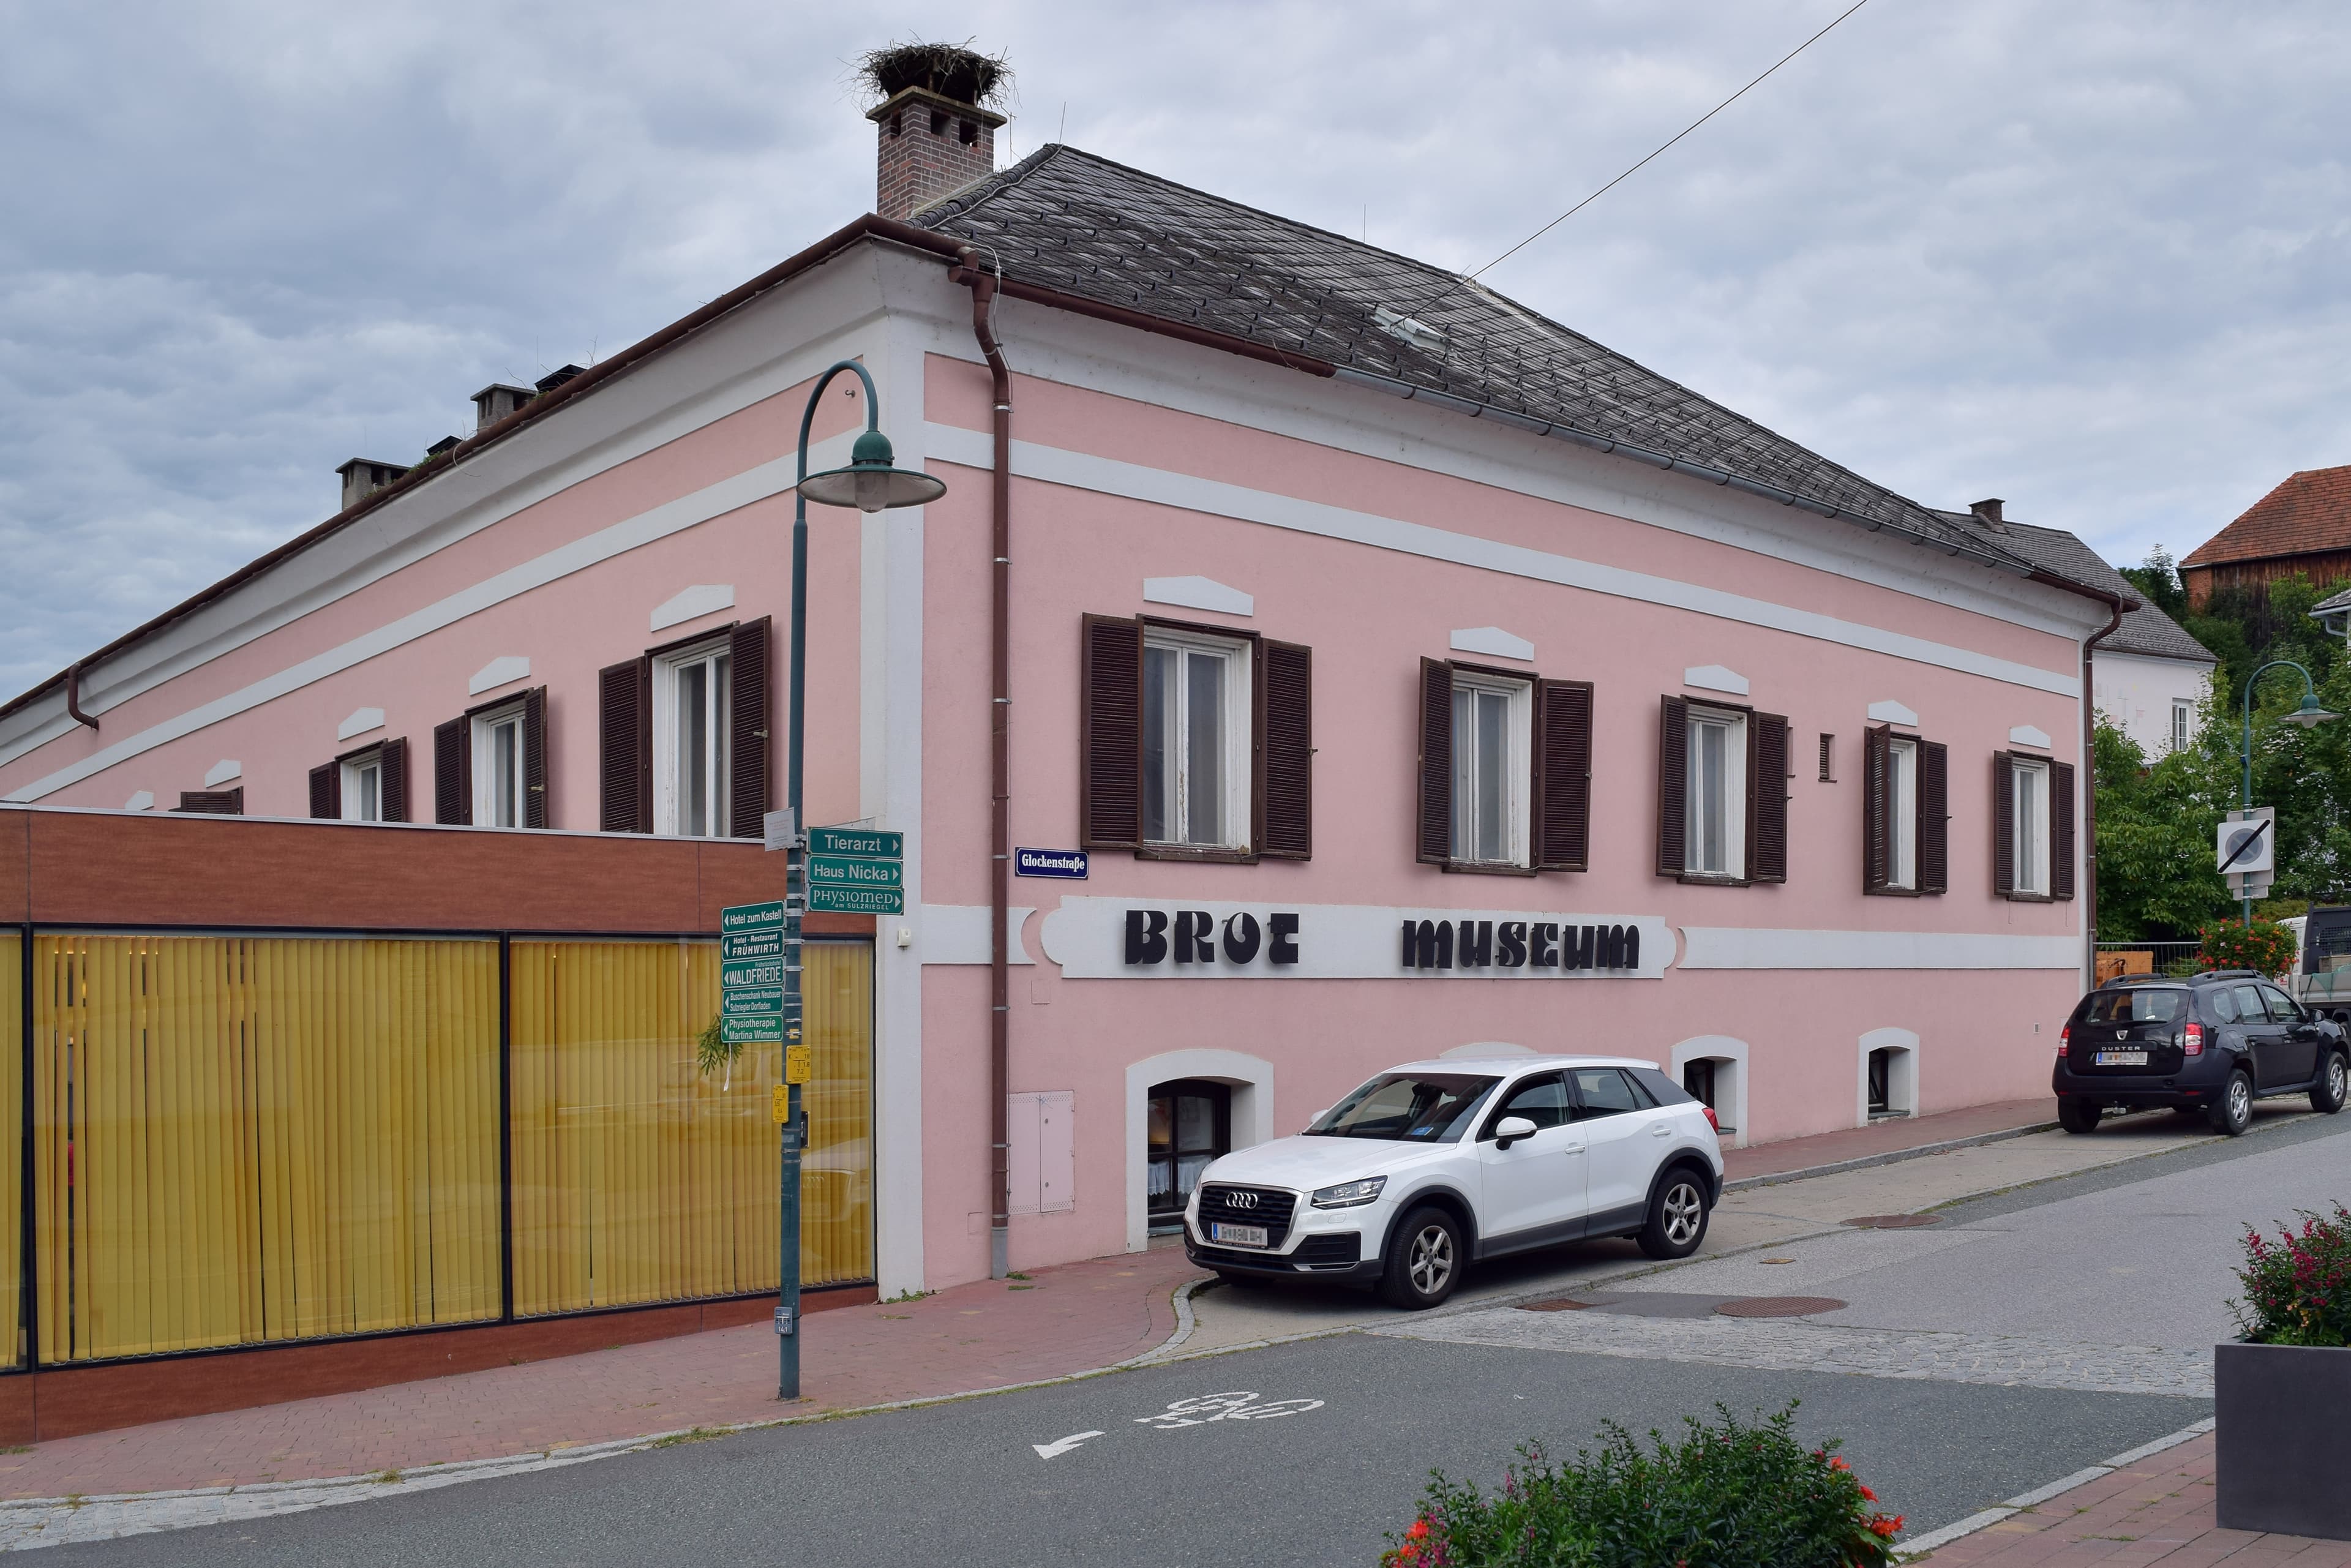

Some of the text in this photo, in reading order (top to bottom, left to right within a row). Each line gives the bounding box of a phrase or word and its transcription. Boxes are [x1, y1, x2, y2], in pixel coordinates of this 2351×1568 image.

[824, 835, 882, 852] Tierarzt
[1021, 853, 1085, 872] Glockenstraße
[814, 864, 888, 880] Haus Nicka
[730, 909, 782, 925] Hotel zum Kastell
[751, 933, 778, 942] Restaurant
[732, 943, 779, 956] FRÜHWIRTH
[729, 967, 781, 985] WALDFRIEDE
[730, 990, 781, 1000] Buschenschank Neubauer
[751, 1001, 771, 1010] Dorfladen
[729, 1018, 776, 1030] Physiotherapie
[729, 1029, 781, 1040] Martina Wimmer
